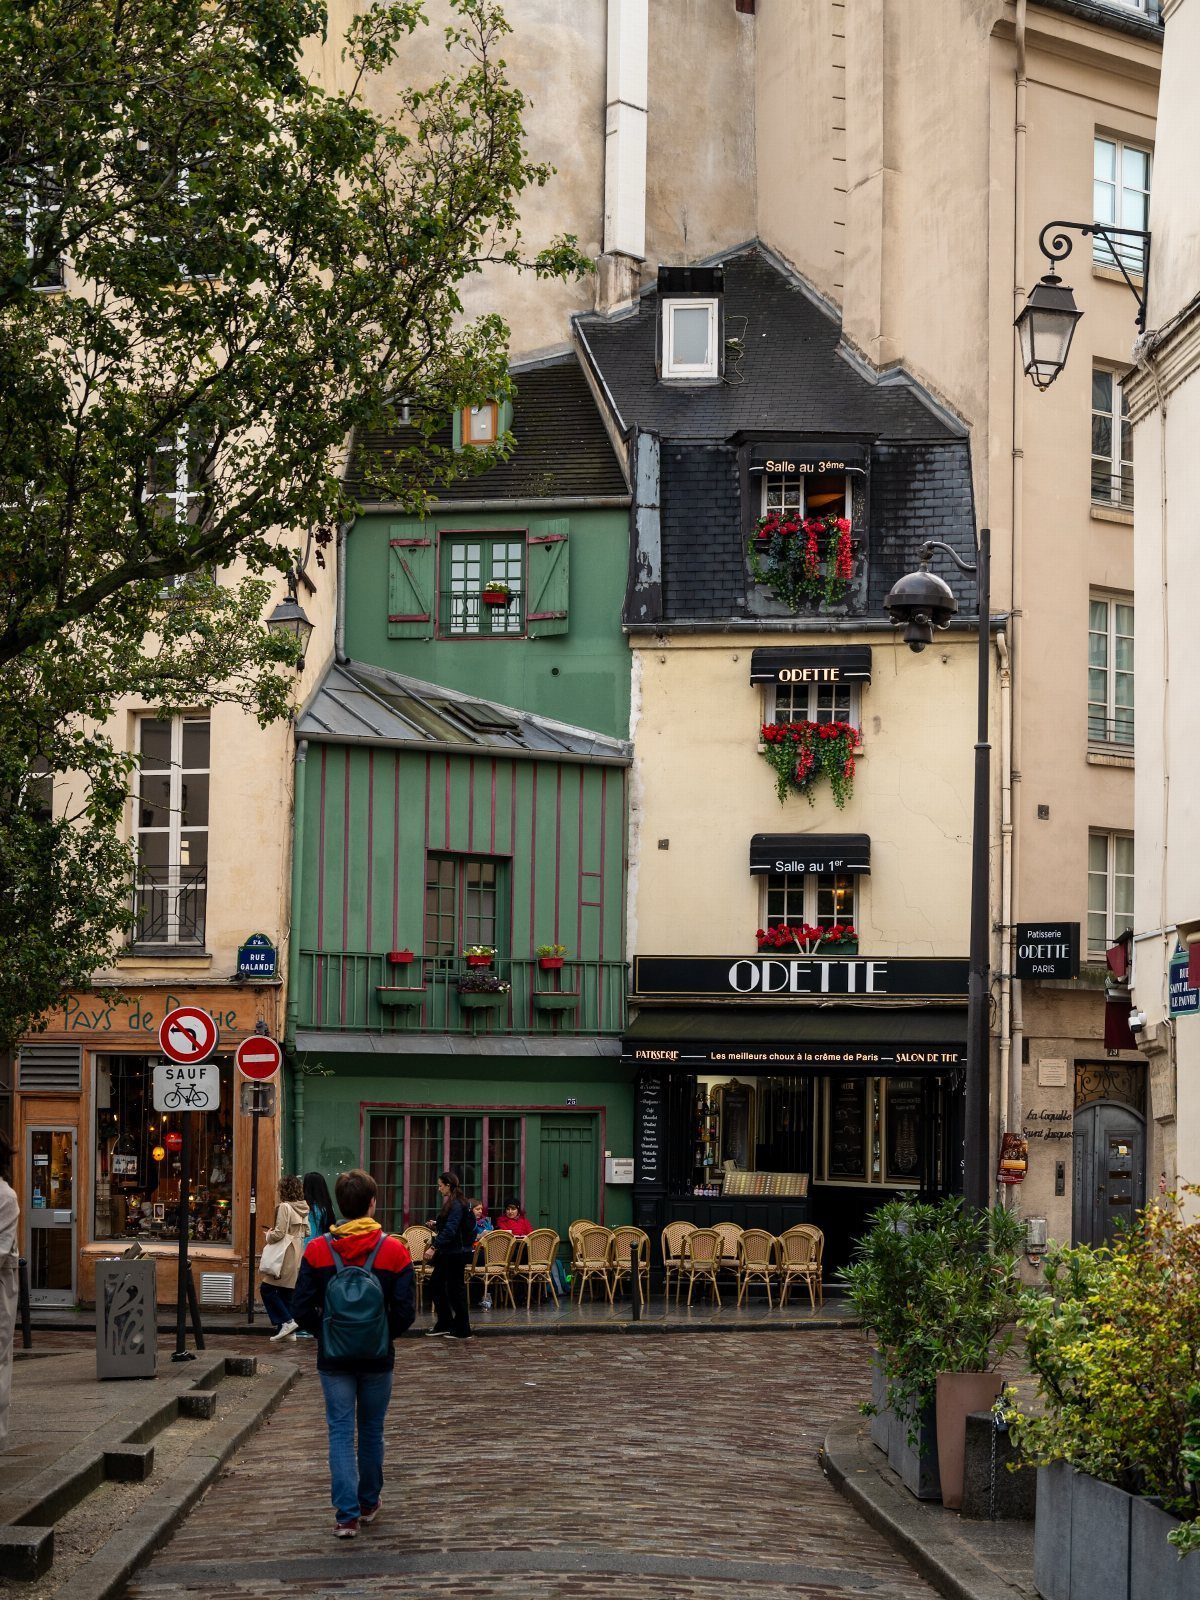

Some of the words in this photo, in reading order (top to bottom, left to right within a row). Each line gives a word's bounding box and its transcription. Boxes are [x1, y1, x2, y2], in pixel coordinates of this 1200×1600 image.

[765, 460, 796, 473] Salle
[799, 463, 814, 473] au
[778, 668, 840, 682] ODETTE
[775, 860, 805, 872] Salle
[809, 863, 824, 872] au
[828, 860, 844, 872] 1er
[1027, 930, 1062, 939] Patisserie
[250, 953, 266, 961] RUE
[1018, 943, 1070, 959] ODETTE
[240, 963, 275, 971] GALANDE
[1032, 964, 1055, 973] PARIS
[728, 959, 888, 993] ODETTE
[1169, 982, 1183, 994] SAINT
[1171, 997, 1178, 1008] LE
[1178, 994, 1197, 1007] PAUVRE
[128, 999, 154, 1032] de
[635, 1050, 680, 1062] PATISSERIE
[710, 1052, 726, 1060] Les
[728, 1052, 767, 1060] meilleurs
[769, 1053, 795, 1061] choux
[796, 1053, 803, 1061] à
[804, 1053, 813, 1061] la
[842, 1053, 854, 1061] de
[856, 1053, 879, 1062] Paris
[895, 1052, 925, 1063] SALON
[927, 1053, 939, 1063] DE
[165, 1068, 207, 1080] SAUF
[1026, 1109, 1038, 1119] La
